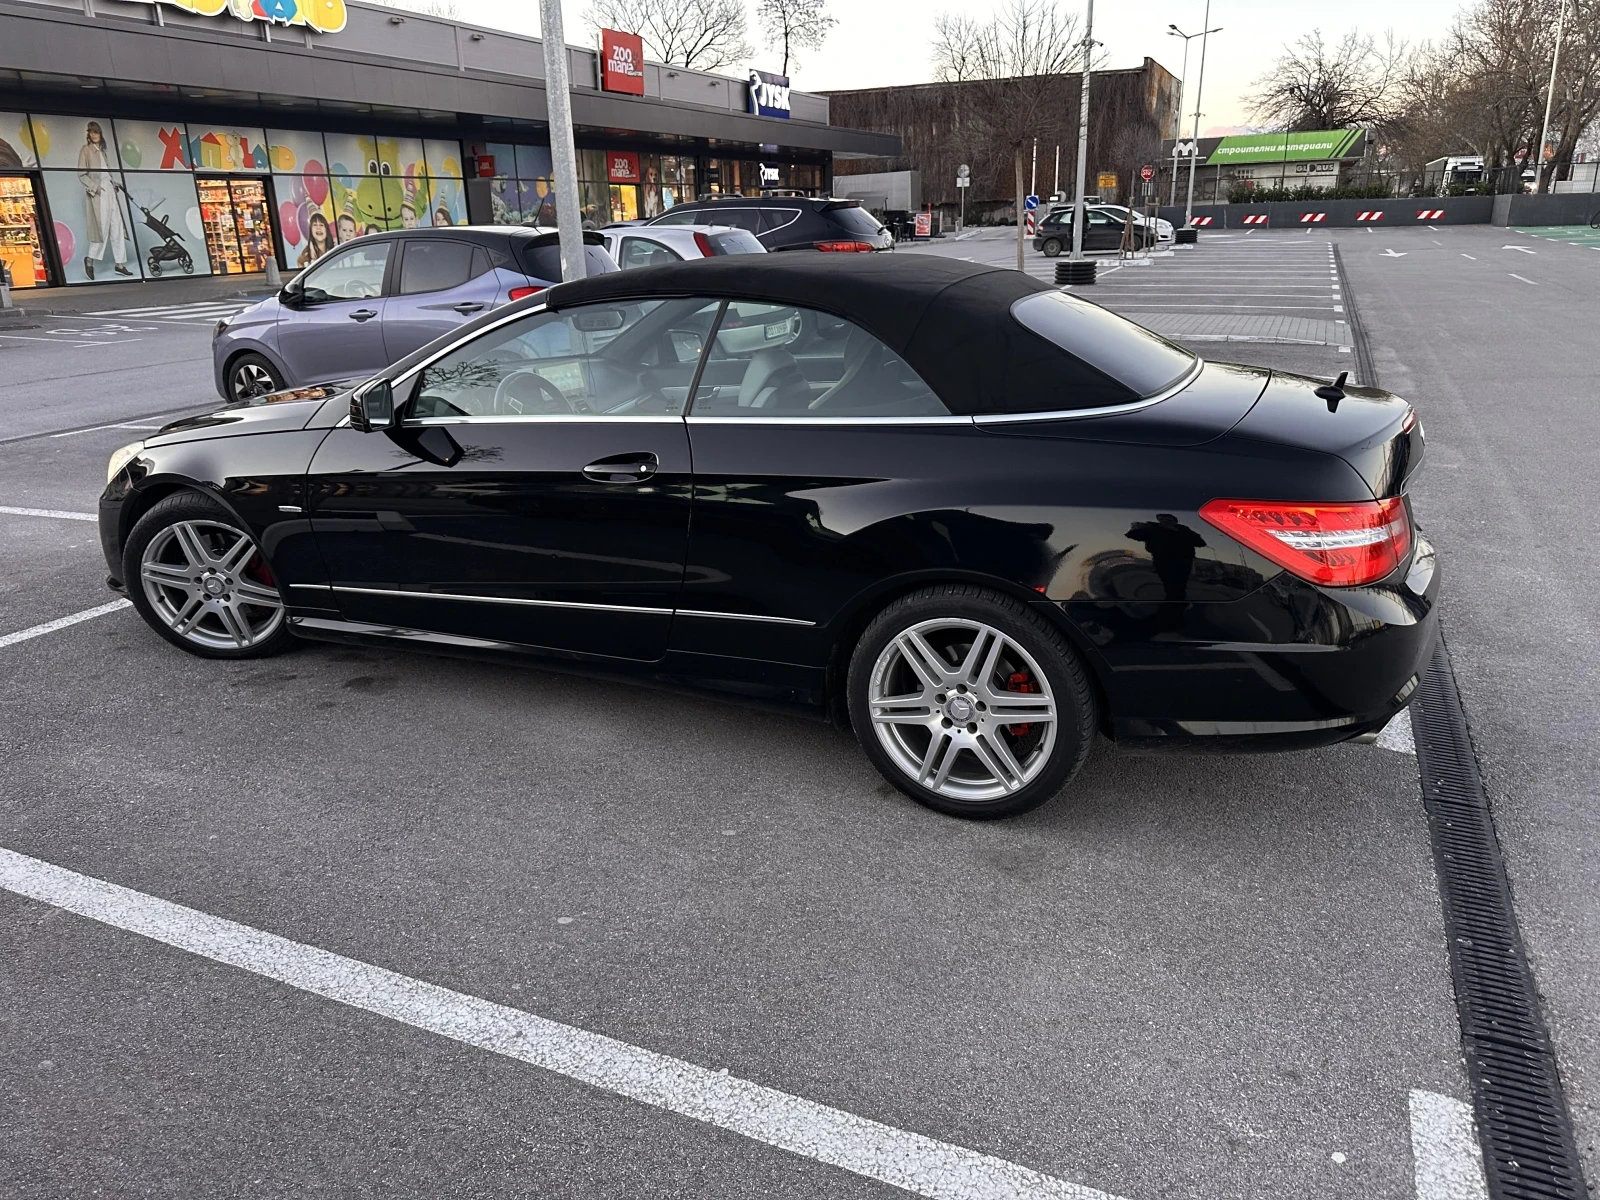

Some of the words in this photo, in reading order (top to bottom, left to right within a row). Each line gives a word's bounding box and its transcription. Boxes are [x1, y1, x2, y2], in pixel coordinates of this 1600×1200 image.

[758, 82, 790, 110] JYSK
[1217, 145, 1277, 156] строителни
[763, 167, 780, 181] JYSK
[1296, 163, 1335, 173] GLOBUS
